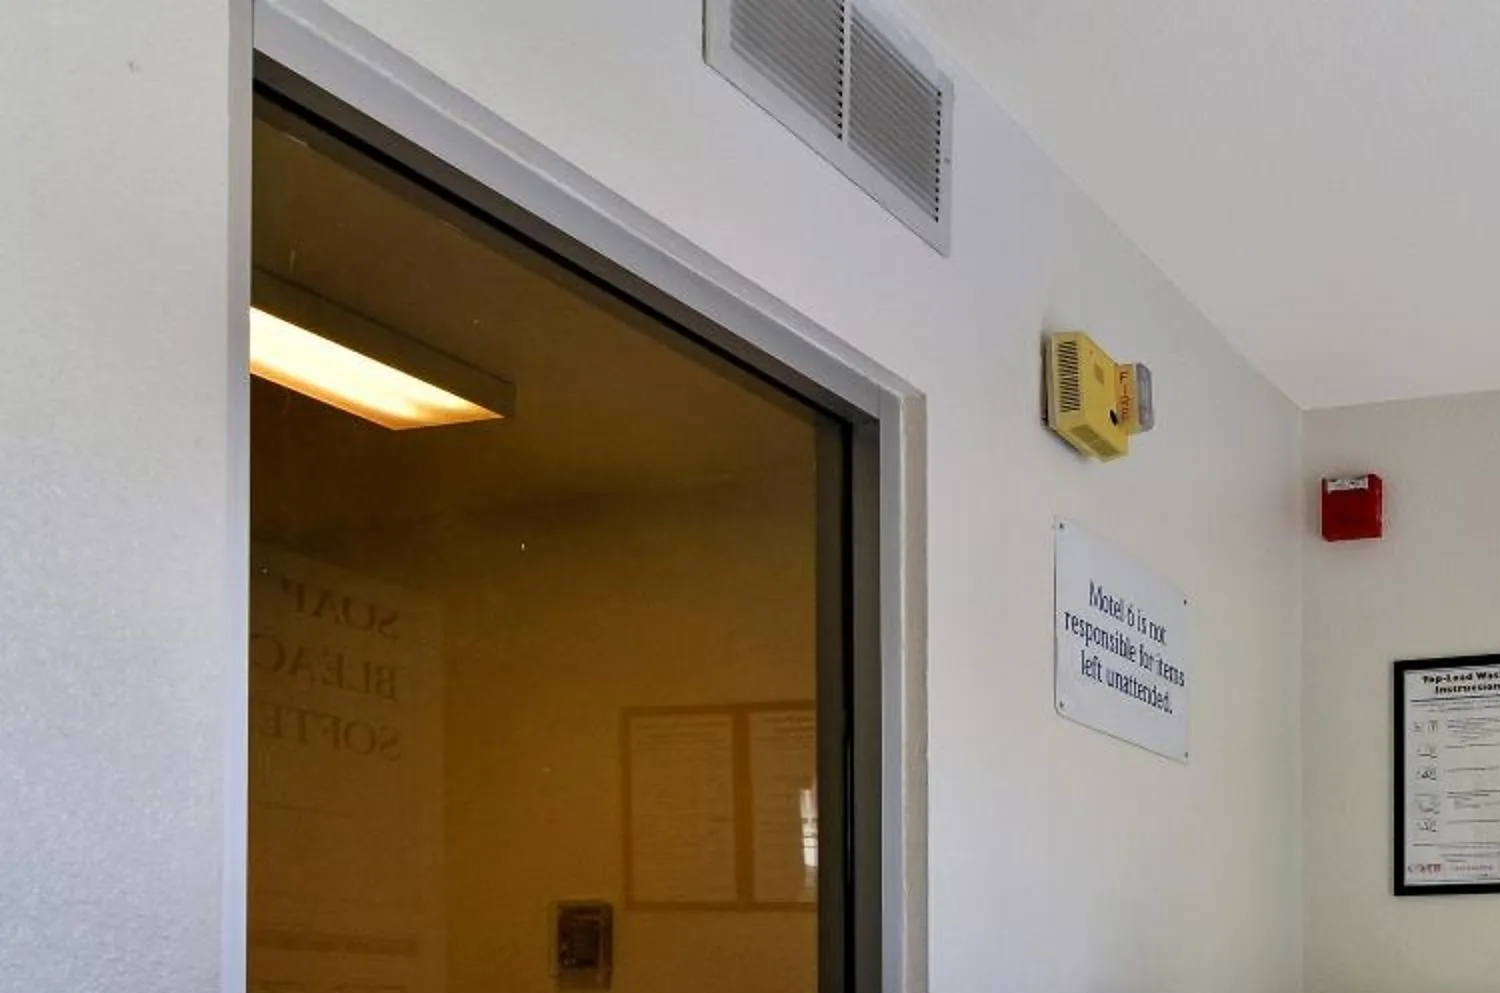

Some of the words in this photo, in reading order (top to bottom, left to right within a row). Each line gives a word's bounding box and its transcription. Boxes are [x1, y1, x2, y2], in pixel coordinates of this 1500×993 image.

[1089, 578, 1125, 623] Motel
[1127, 603, 1135, 628] 6
[1137, 609, 1148, 635] is
[1149, 621, 1168, 646] not
[1063, 610, 1137, 663] responsible
[1139, 644, 1154, 673] for
[1156, 651, 1185, 687] items
[1081, 649, 1104, 684] left
[1106, 668, 1174, 715] unattended.
[1421, 672, 1473, 685] Top-Load
